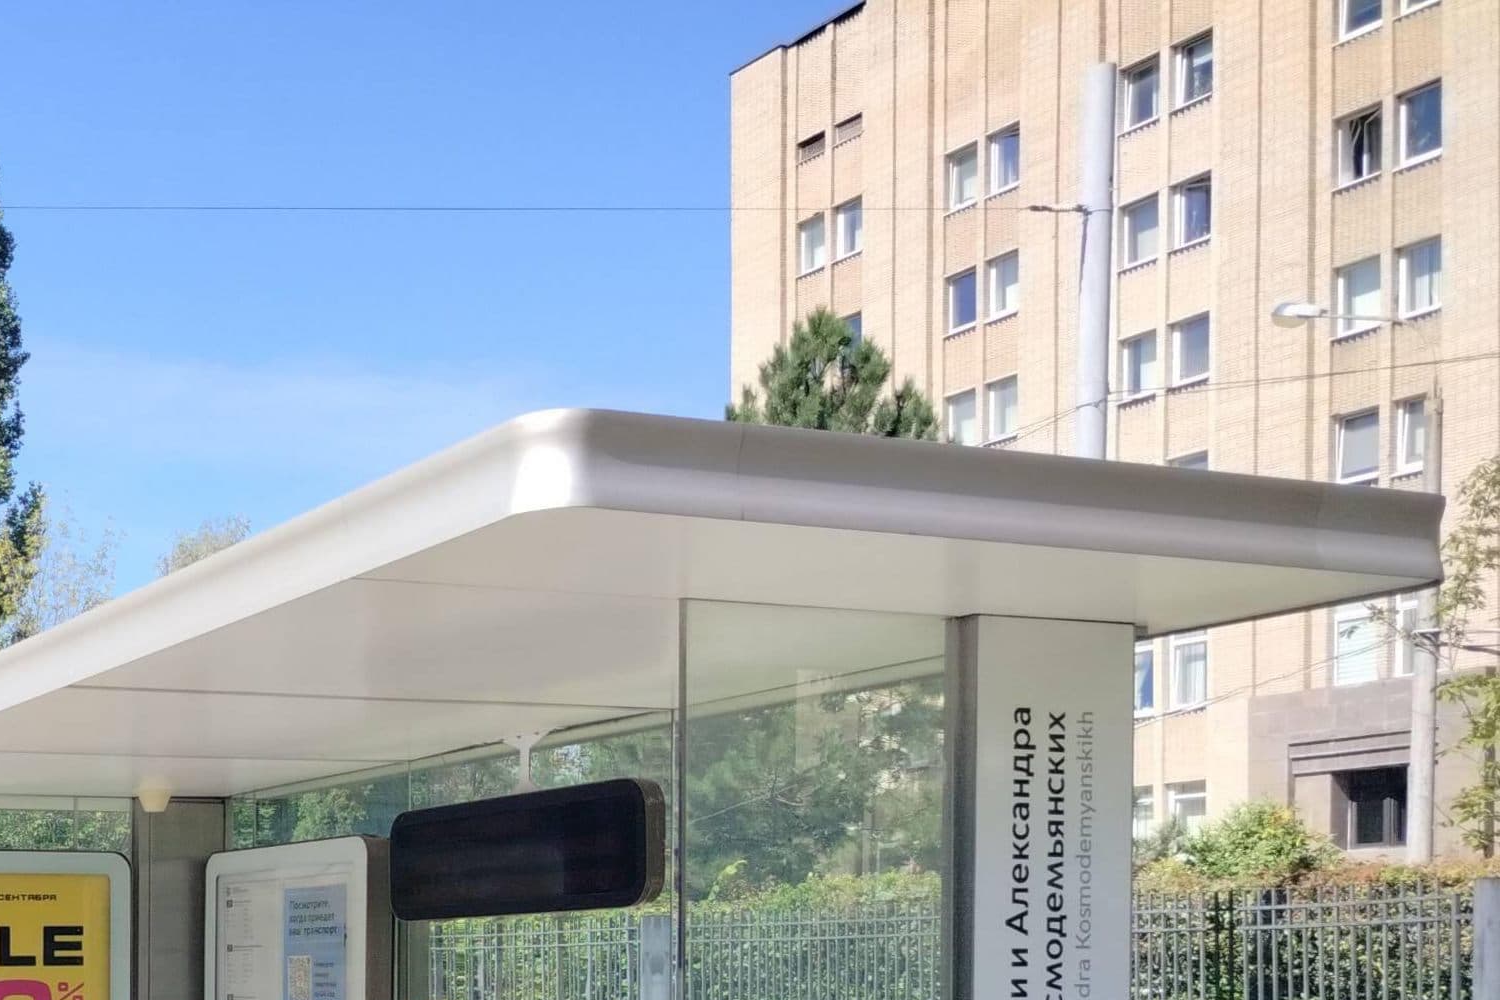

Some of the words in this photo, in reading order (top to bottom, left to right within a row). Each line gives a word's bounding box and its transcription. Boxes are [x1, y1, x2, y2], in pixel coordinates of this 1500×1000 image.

[1005, 707, 1036, 936] Александра
[1075, 712, 1097, 949] Kosmodemyanskikh
[1011, 948, 1029, 967] и
